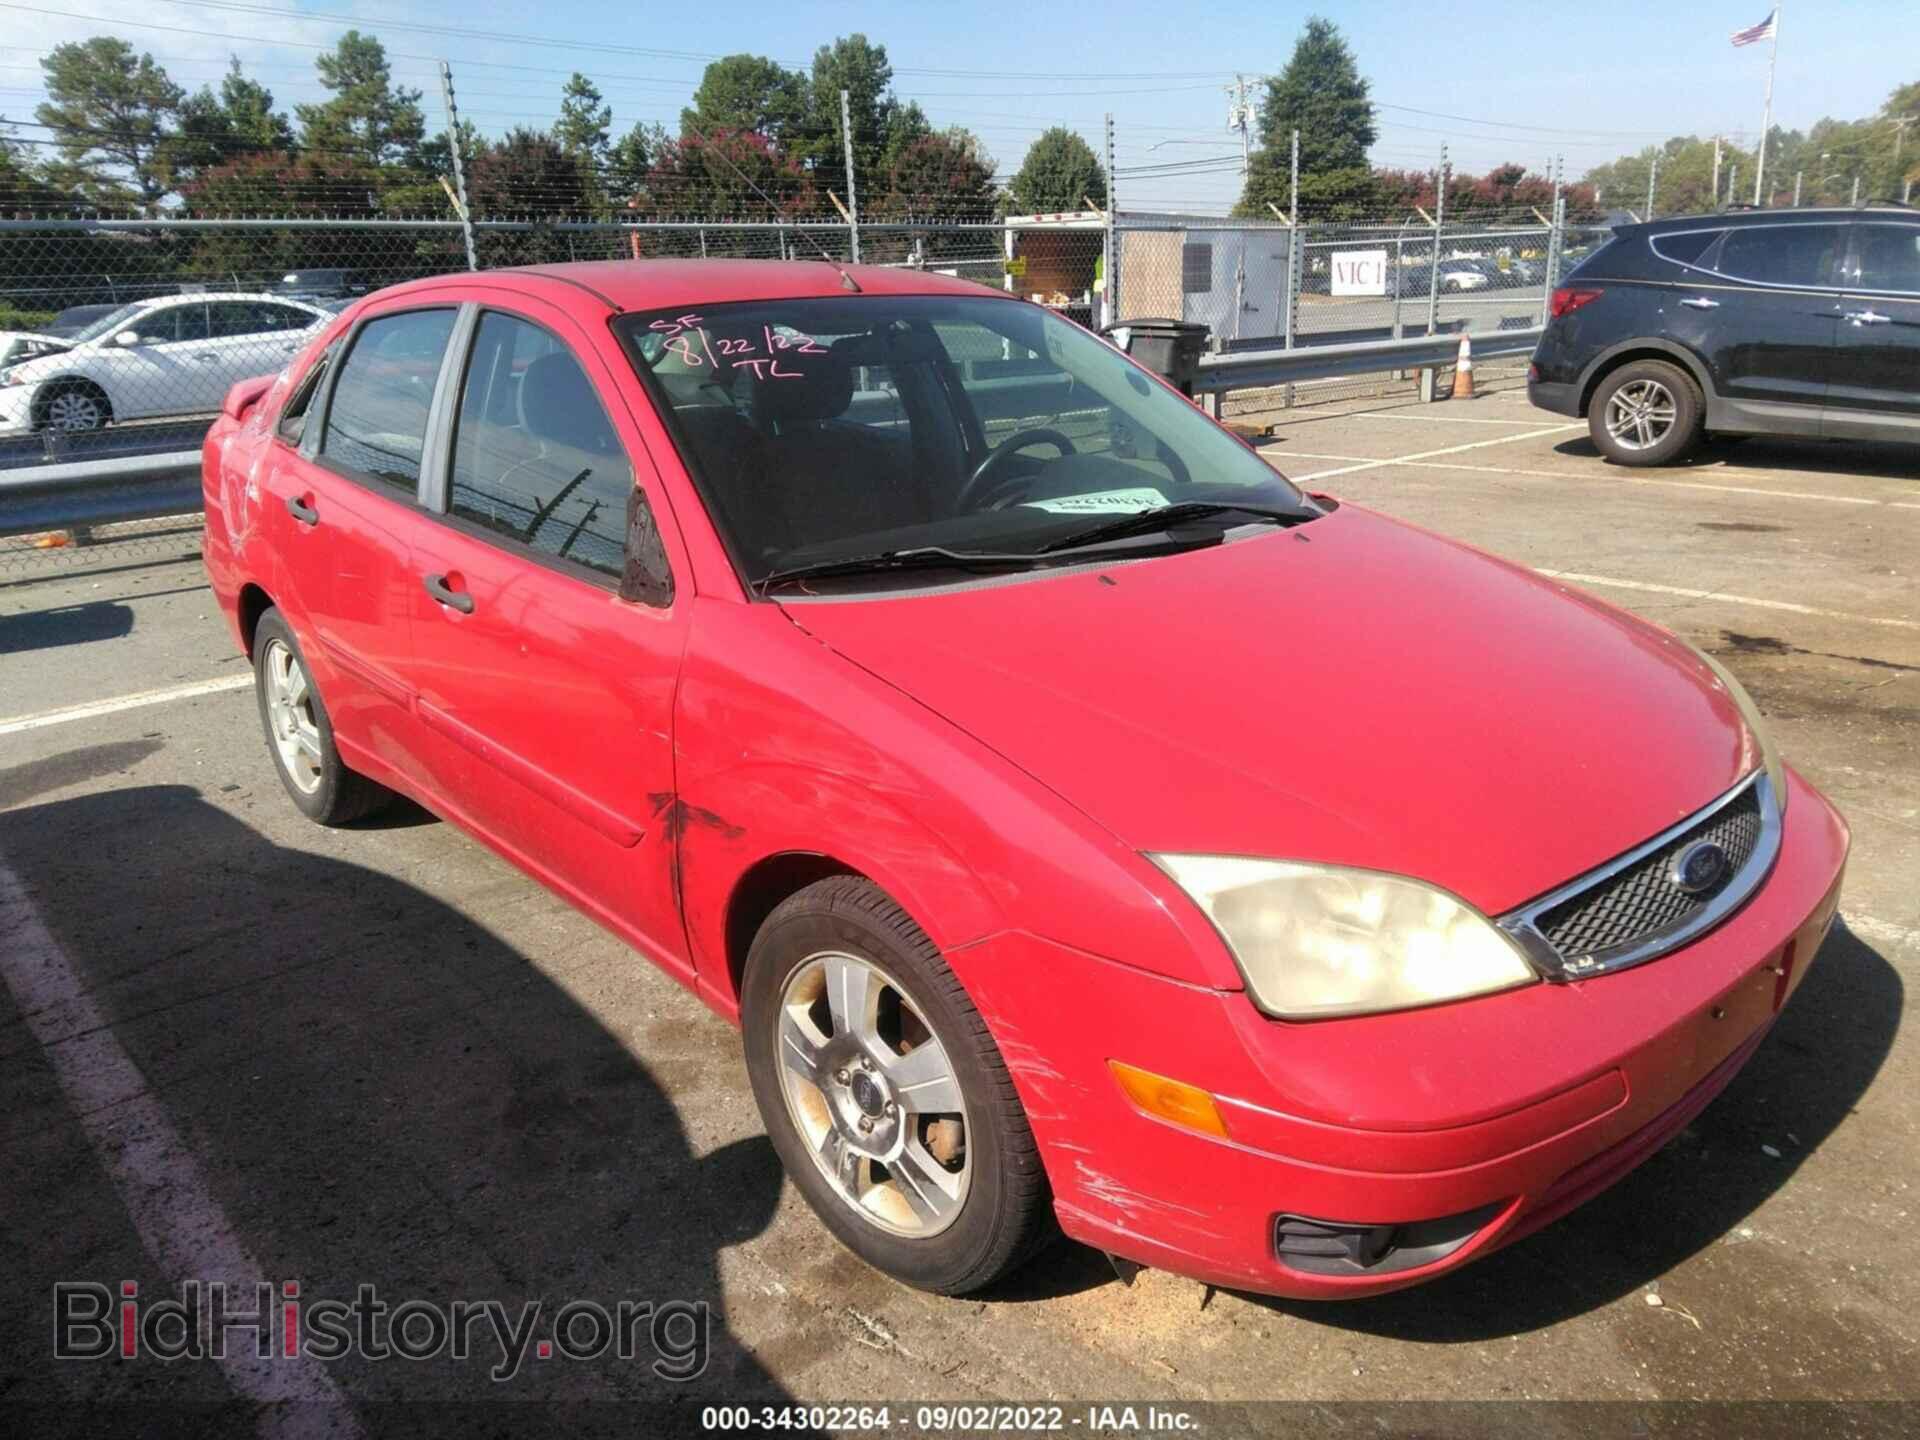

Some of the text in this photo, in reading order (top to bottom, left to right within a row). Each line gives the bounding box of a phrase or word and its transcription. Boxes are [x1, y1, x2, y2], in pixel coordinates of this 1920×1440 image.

[1336, 261, 1369, 285] VIC
[649, 314, 703, 335] SF
[731, 359, 804, 380] TL
